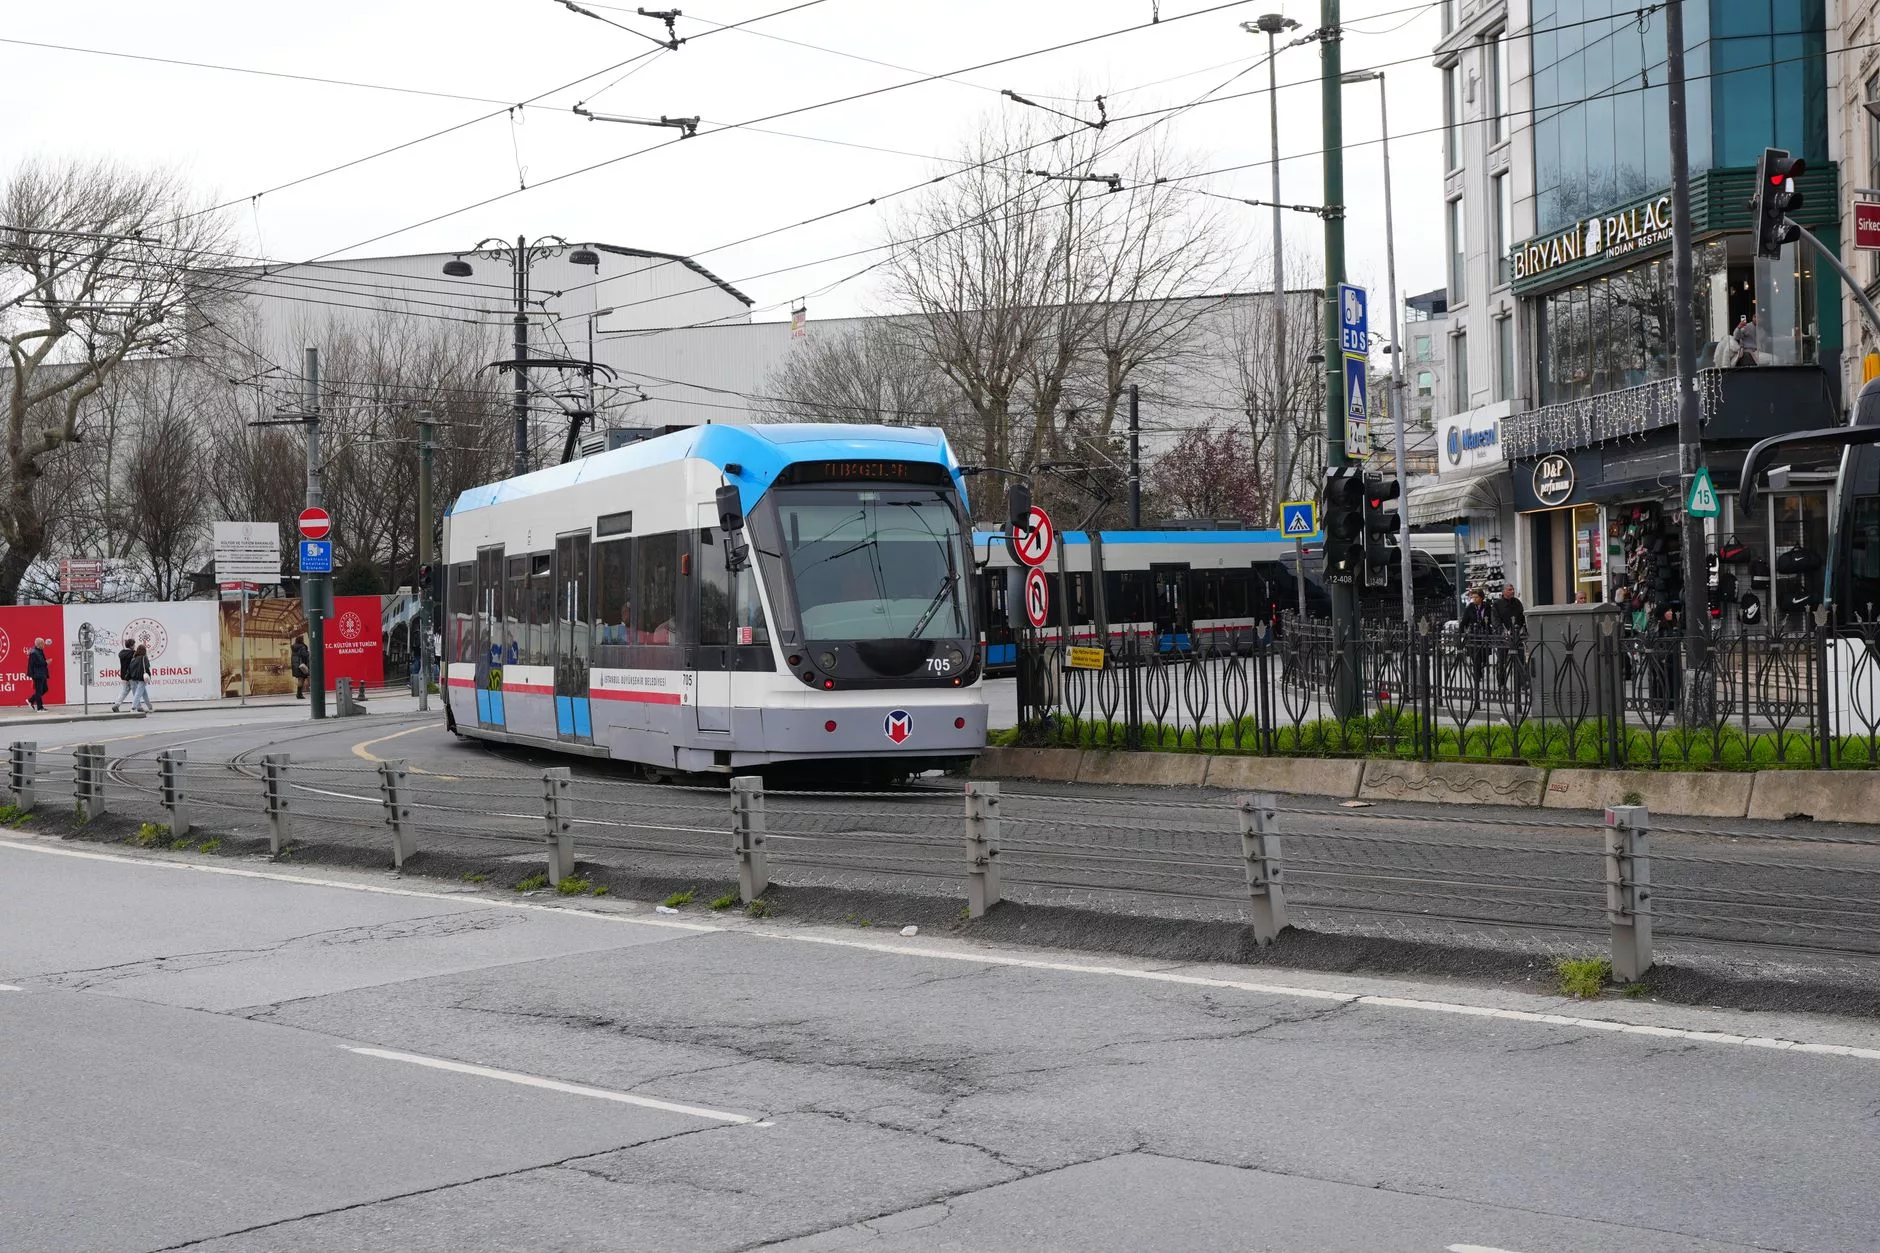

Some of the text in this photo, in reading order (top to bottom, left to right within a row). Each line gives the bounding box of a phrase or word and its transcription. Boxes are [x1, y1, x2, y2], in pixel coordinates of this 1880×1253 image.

[1858, 217, 1880, 231] Sirkec
[1514, 197, 1671, 280] BİRYANİ PALAC
[1606, 241, 1634, 259] INDIAN
[1343, 328, 1366, 351] EDS
[1543, 459, 1563, 479] D&P
[1697, 489, 1710, 505] 15
[1329, 575, 1353, 584] 12-408
[99, 667, 121, 678] SİRK
[160, 665, 192, 676] BİNASI
[926, 658, 950, 671] 705
[682, 673, 693, 686] 705
[0, 682, 15, 692] IĞI
